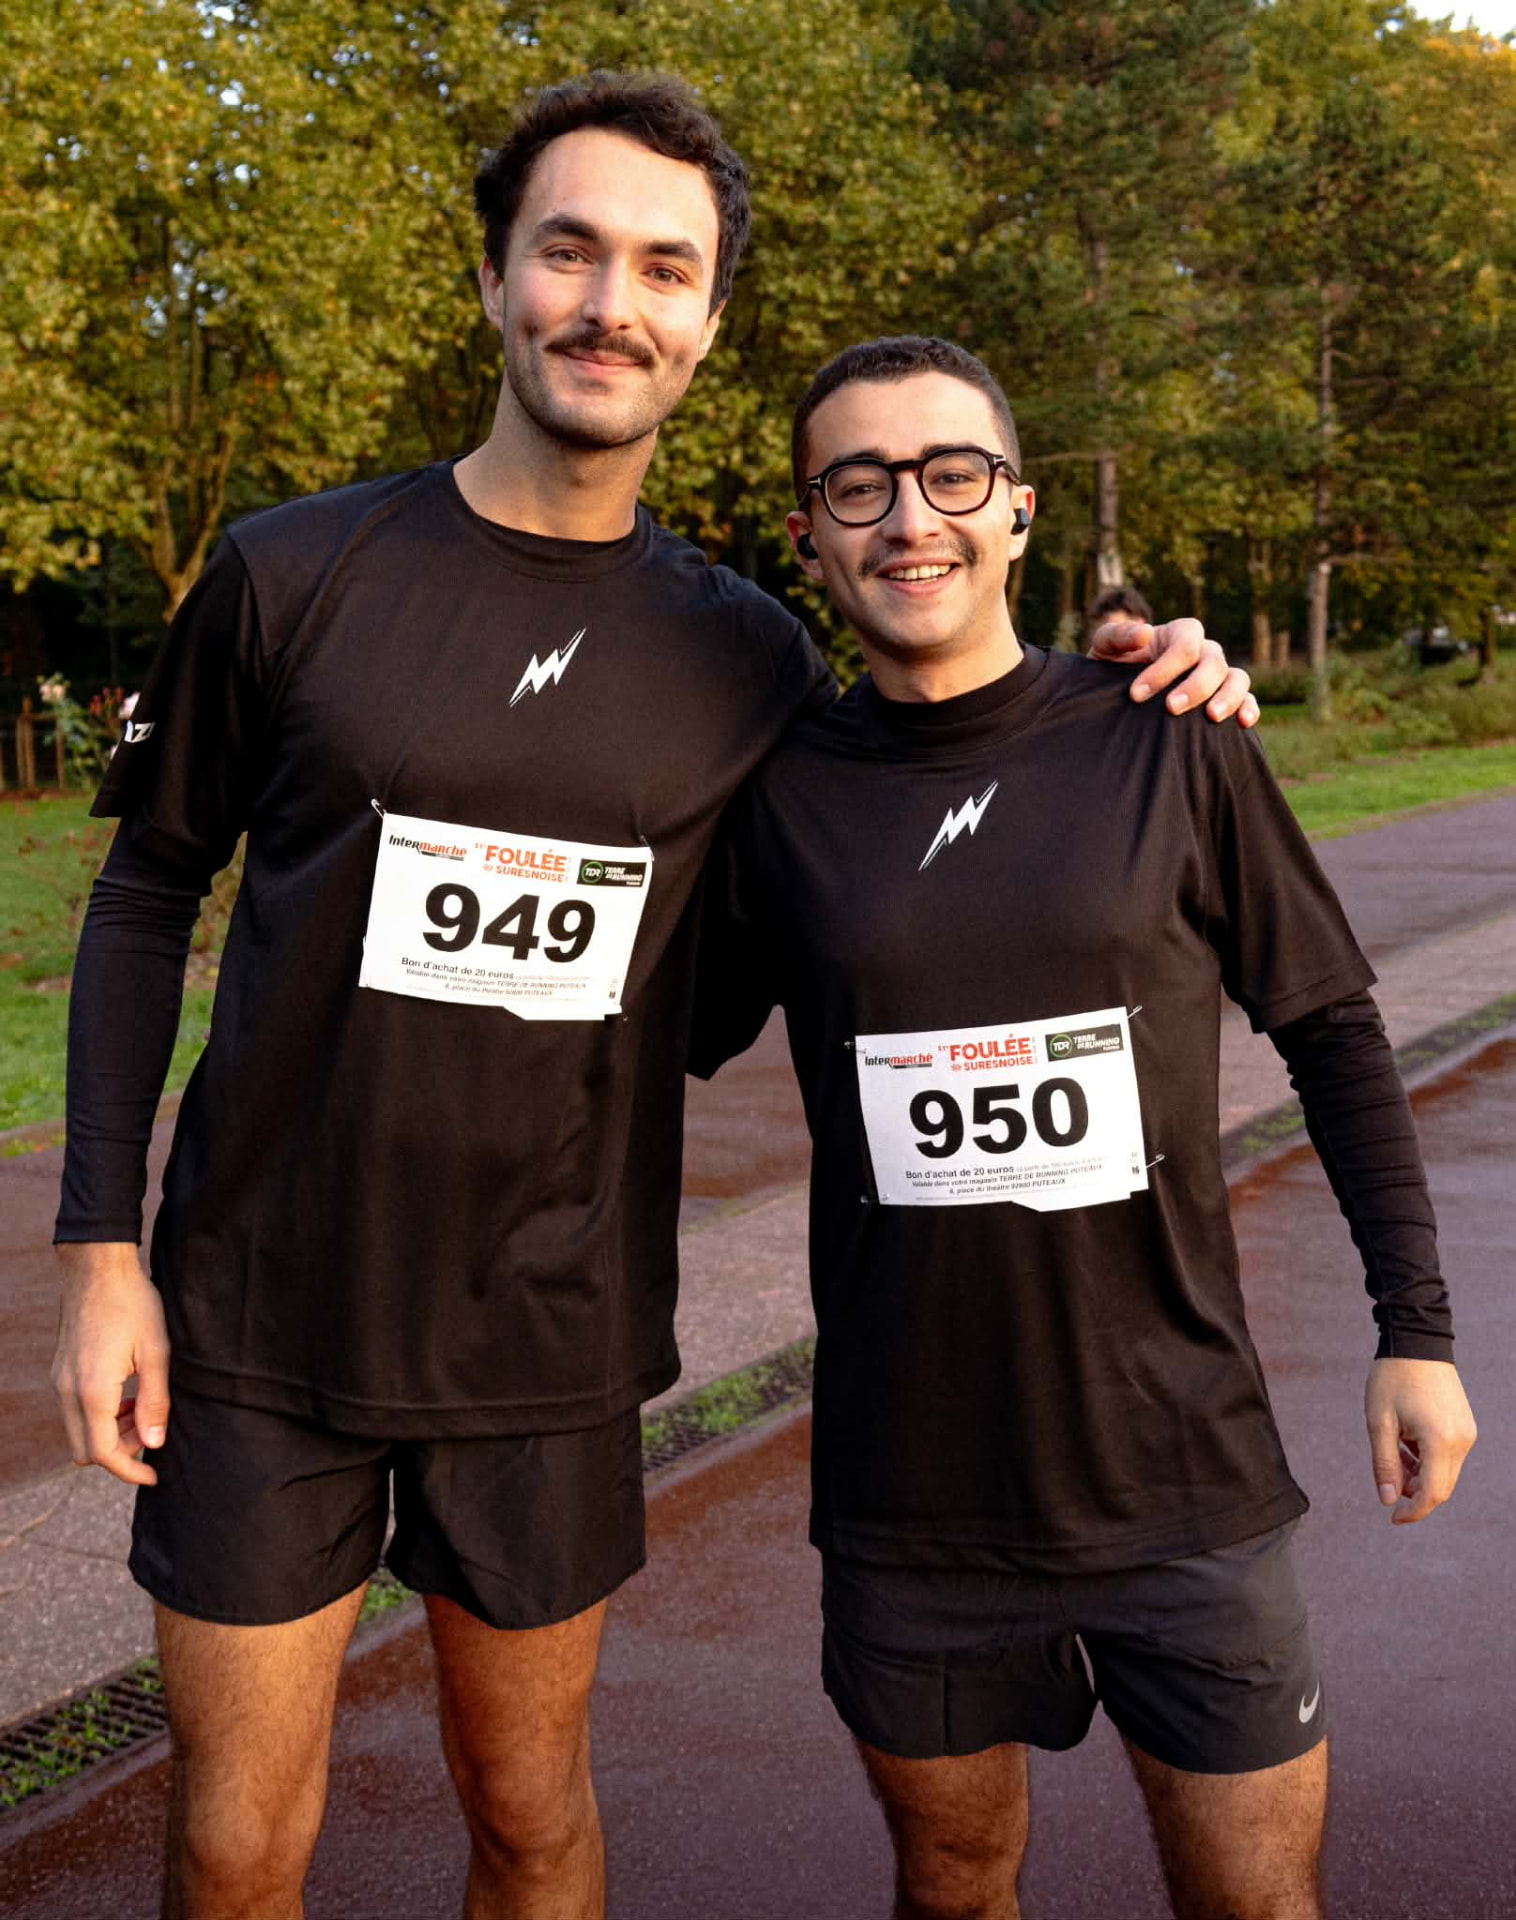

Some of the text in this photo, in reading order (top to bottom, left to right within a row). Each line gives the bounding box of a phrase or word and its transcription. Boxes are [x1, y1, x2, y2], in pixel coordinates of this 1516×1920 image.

[485, 845, 567, 872] FOULÉE
[496, 865, 564, 883] SURESNOISE
[585, 867, 601, 877] TDR
[423, 882, 596, 963] 949
[401, 957, 421, 967] Bon
[460, 967, 473, 976] de
[475, 968, 486, 977] 20
[488, 971, 514, 980] euros
[1053, 1041, 1070, 1052] TDR
[1073, 1034, 1096, 1044] TERRE
[950, 1034, 1032, 1061] FOULÉE
[964, 1056, 1033, 1071] SURESNOISE
[909, 1077, 1089, 1159] 950
[905, 1166, 1015, 1179] Bon d'achat de 20 euros
[999, 1174, 1023, 1182] TERRE
[1032, 1178, 1066, 1188] PUTEAUX
